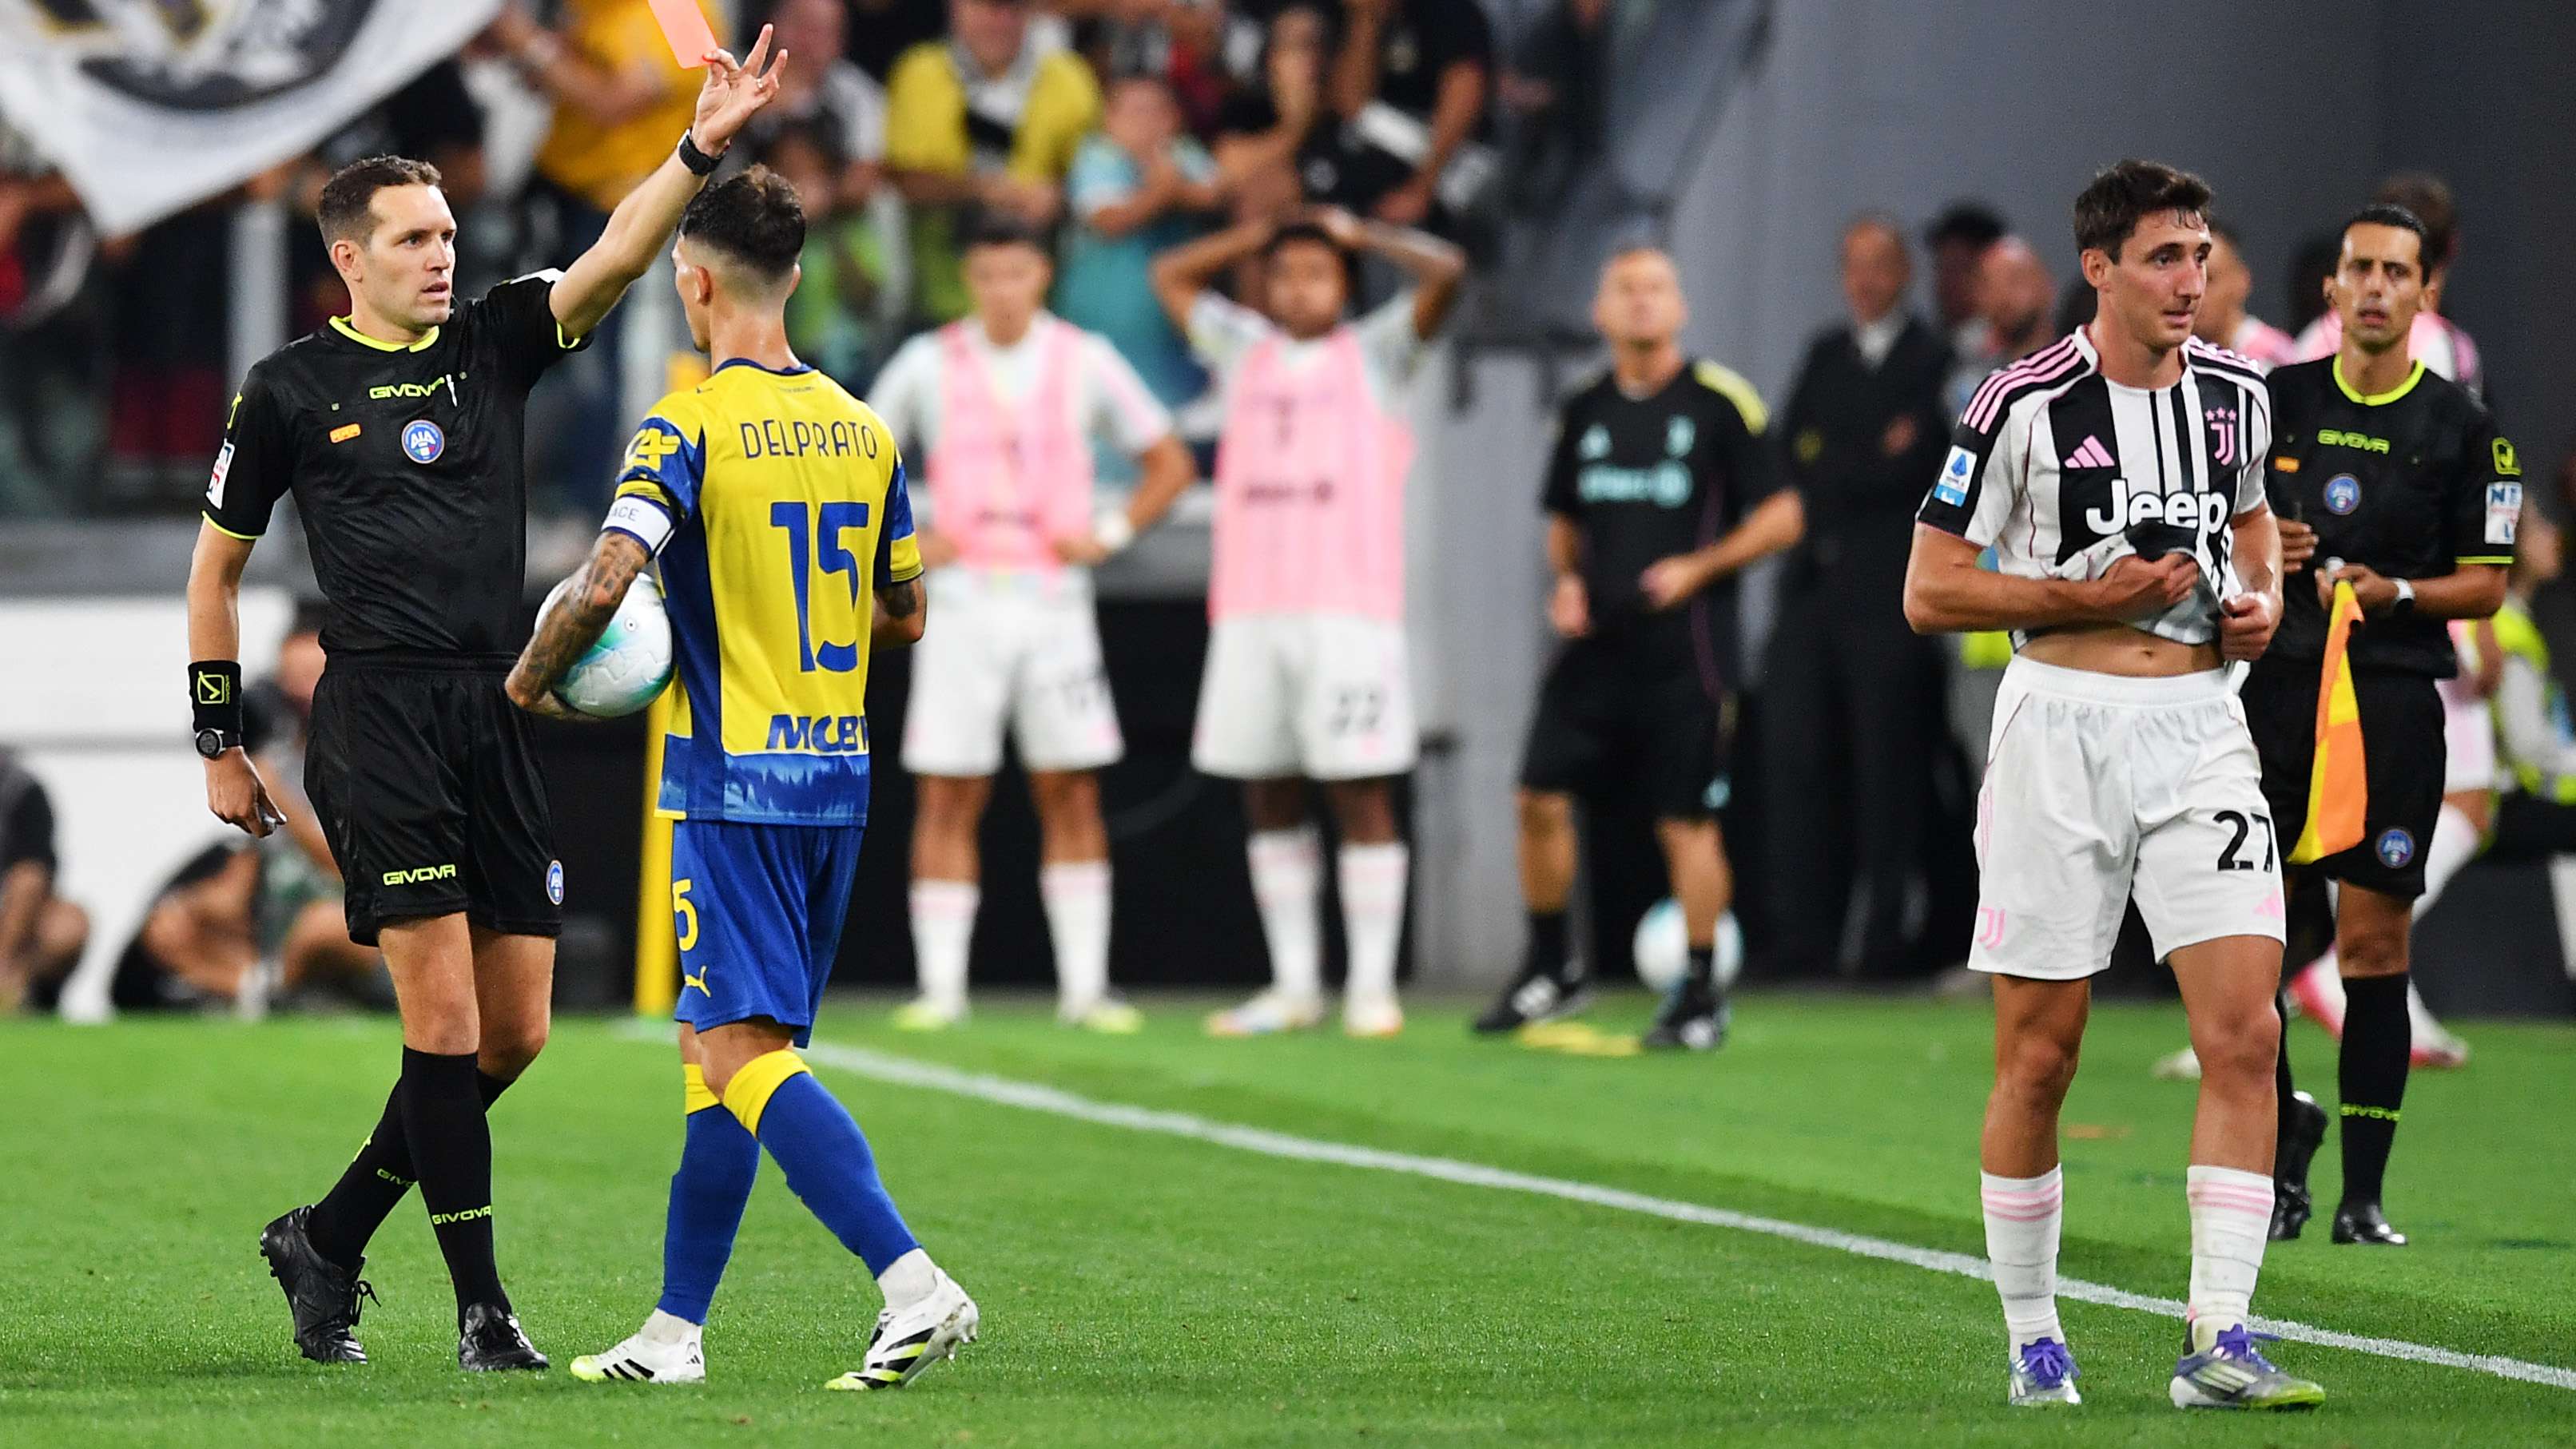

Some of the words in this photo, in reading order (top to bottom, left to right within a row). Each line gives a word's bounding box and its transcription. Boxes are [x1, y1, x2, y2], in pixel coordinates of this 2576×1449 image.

[740, 419, 878, 459] DELPRATO
[2317, 429, 2390, 454] GIVOVA
[2085, 479, 2228, 534] Jeep
[770, 502, 869, 673] 15
[2212, 810, 2273, 873] 27
[383, 863, 456, 886] GIVOVA
[431, 1205, 493, 1225] GIVOVA
